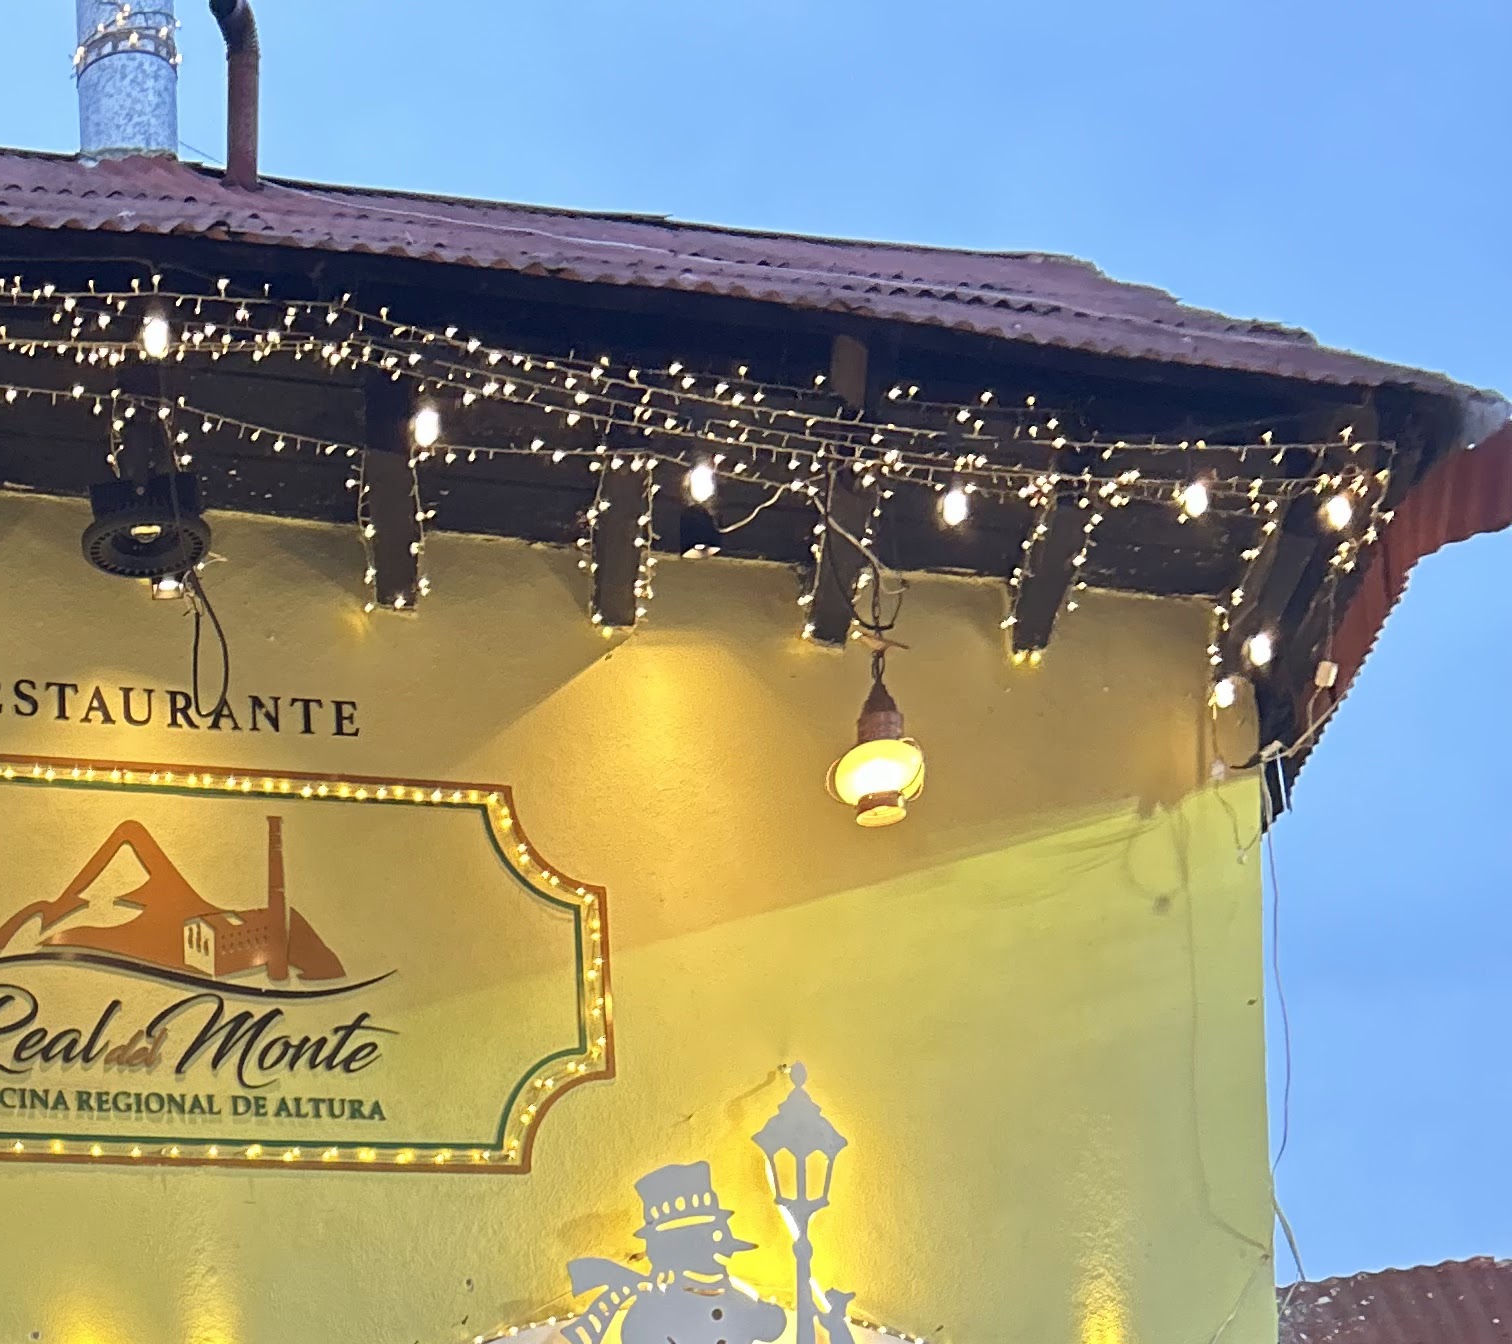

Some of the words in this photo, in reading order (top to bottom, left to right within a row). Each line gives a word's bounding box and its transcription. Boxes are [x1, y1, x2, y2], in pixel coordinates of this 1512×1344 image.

[104, 1027, 168, 1067] del
[144, 993, 400, 1089] Monte
[77, 1089, 221, 1117] REGIONAL
[231, 1095, 267, 1118] DE
[273, 1096, 386, 1122] ALTURA
